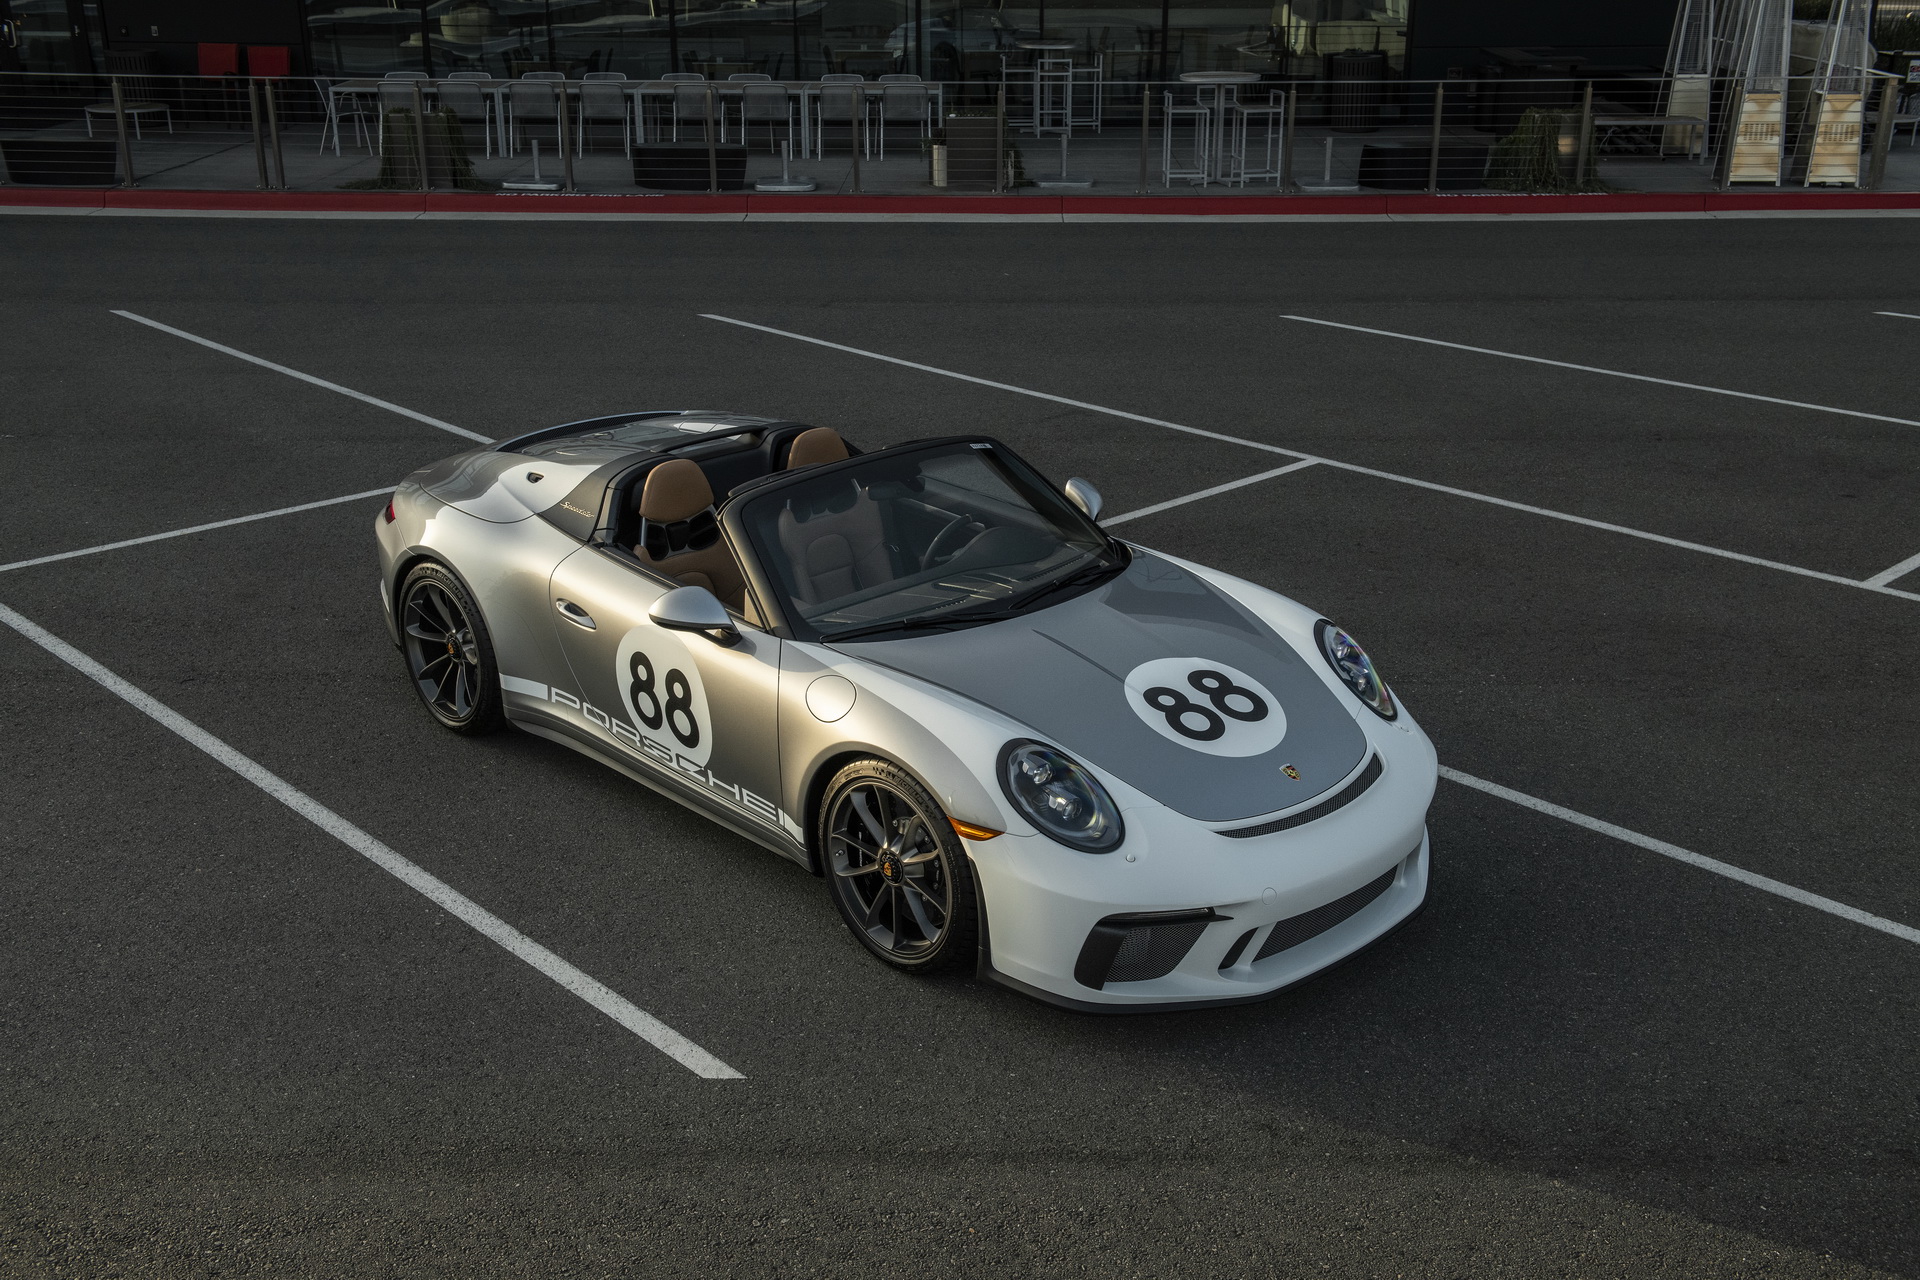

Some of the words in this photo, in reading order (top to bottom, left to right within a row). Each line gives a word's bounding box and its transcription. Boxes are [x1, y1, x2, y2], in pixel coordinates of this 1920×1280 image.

[560, 501, 595, 517] Speedster
[436, 571, 463, 601] MICHELIN
[629, 651, 701, 749] 88
[1142, 669, 1269, 742] 88
[551, 686, 779, 823] PORSCHE
